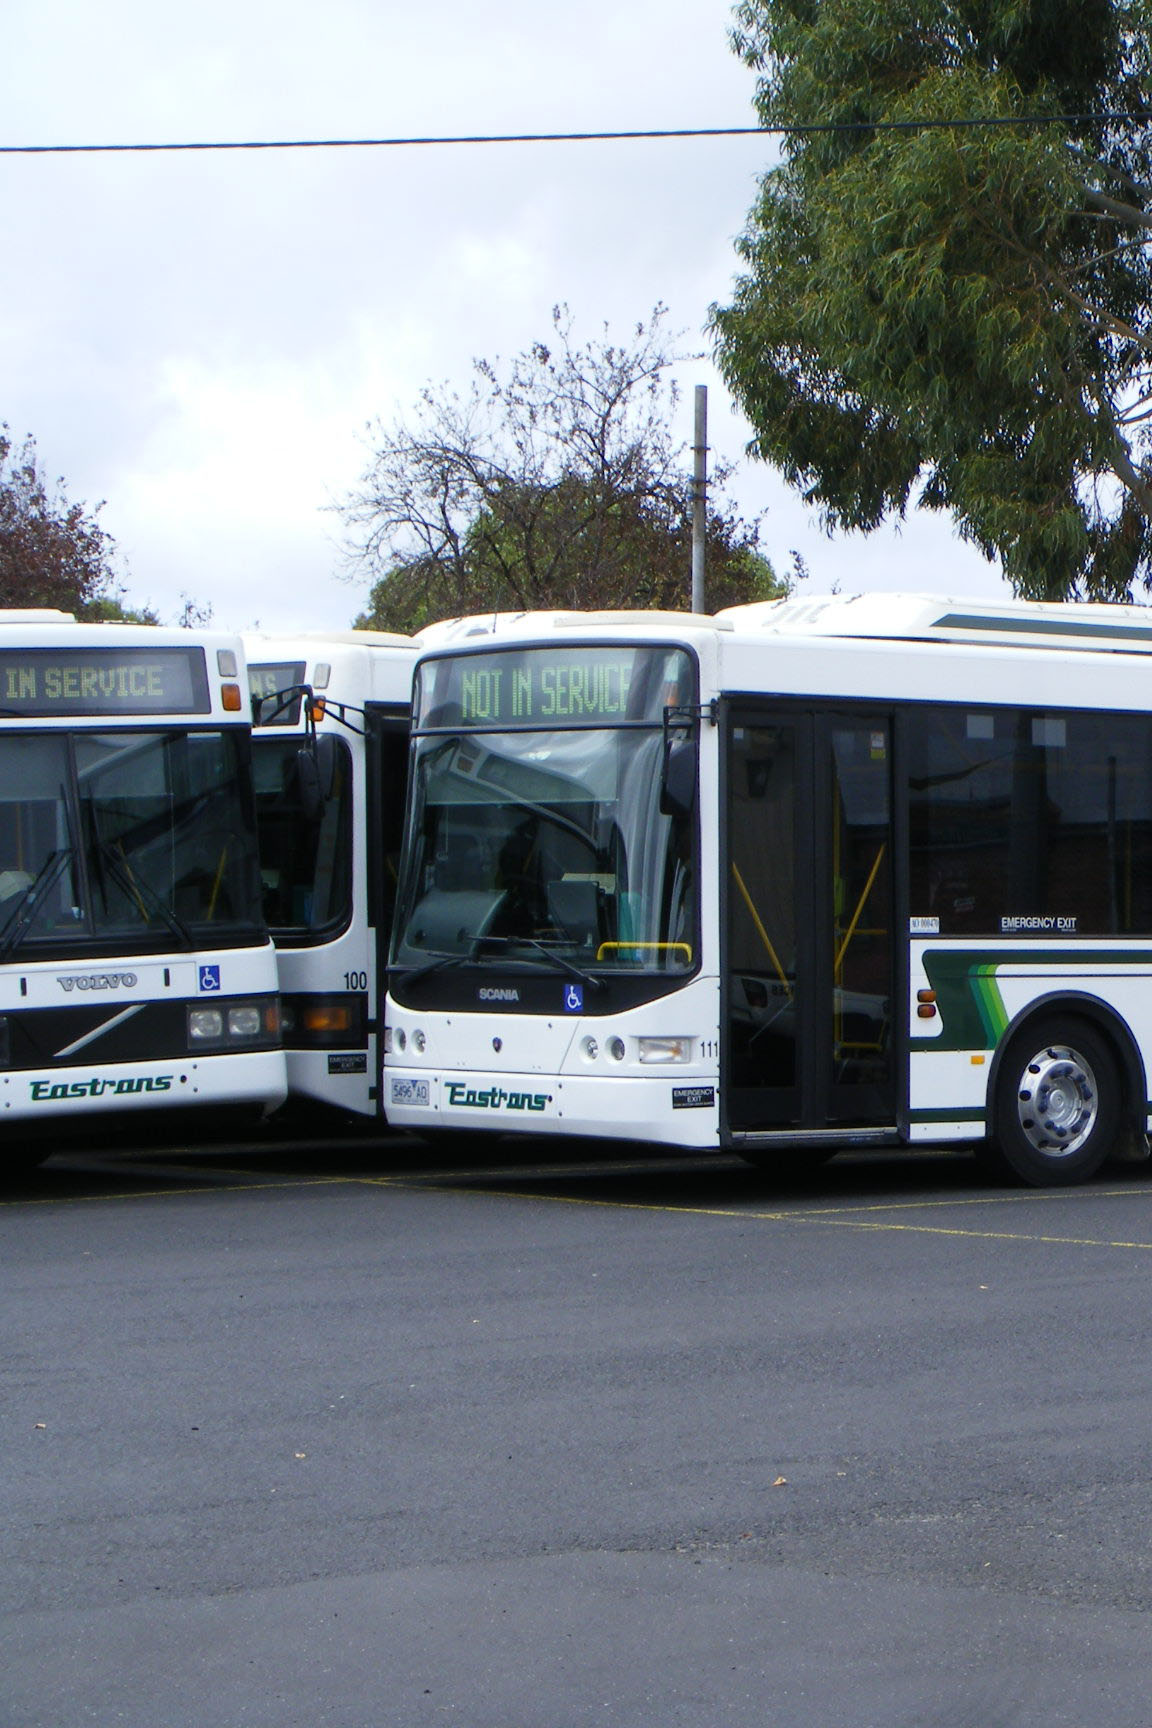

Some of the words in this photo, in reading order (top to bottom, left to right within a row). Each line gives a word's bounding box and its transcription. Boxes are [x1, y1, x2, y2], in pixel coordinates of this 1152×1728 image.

[6, 667, 37, 699] IN
[44, 664, 165, 699] SERVICE
[462, 668, 503, 719] NOT
[511, 668, 533, 717] IN
[541, 663, 634, 715] SERVICE
[1001, 917, 1055, 929] EMERGENCY
[1057, 917, 1077, 929] EXIT
[57, 972, 138, 992] VOLVO
[343, 971, 367, 990] 100
[479, 987, 520, 1002] SCANIA
[700, 1041, 719, 1058] 111
[29, 1075, 174, 1101] Eastrans
[444, 1082, 551, 1112] Eastrans
[673, 1088, 714, 1098] EMERGENCY
